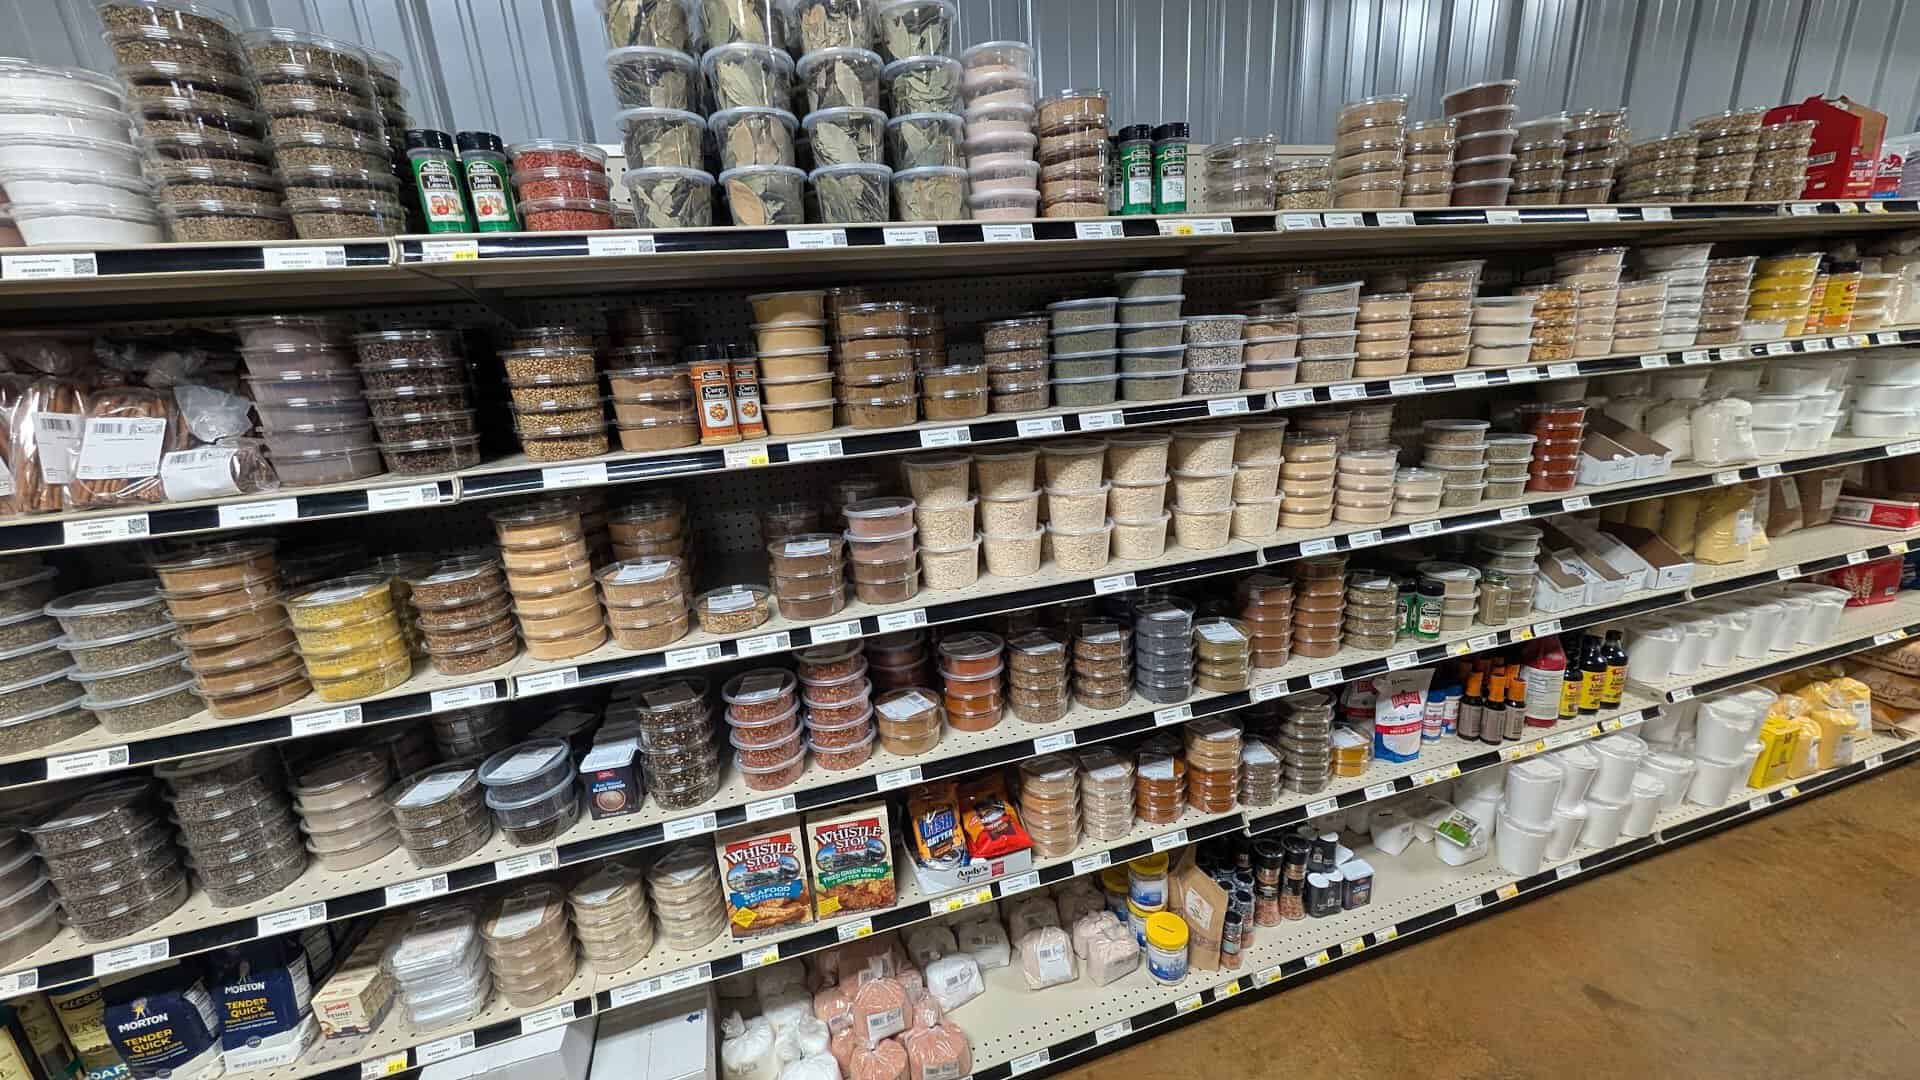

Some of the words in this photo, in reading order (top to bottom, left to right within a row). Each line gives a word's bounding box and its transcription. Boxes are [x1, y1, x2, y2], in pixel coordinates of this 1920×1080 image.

[836, 836, 869, 849] STOP
[746, 853, 780, 867] STOP
[955, 864, 989, 882] Andy's
[744, 886, 791, 899] SEAFOOD
[225, 981, 265, 995] MORTON
[224, 997, 268, 1010] TENDER
[229, 1005, 266, 1018] QUICK
[118, 1013, 169, 1033] MORTON
[123, 1028, 173, 1046] TENDER
[131, 1037, 171, 1053] QUICK
